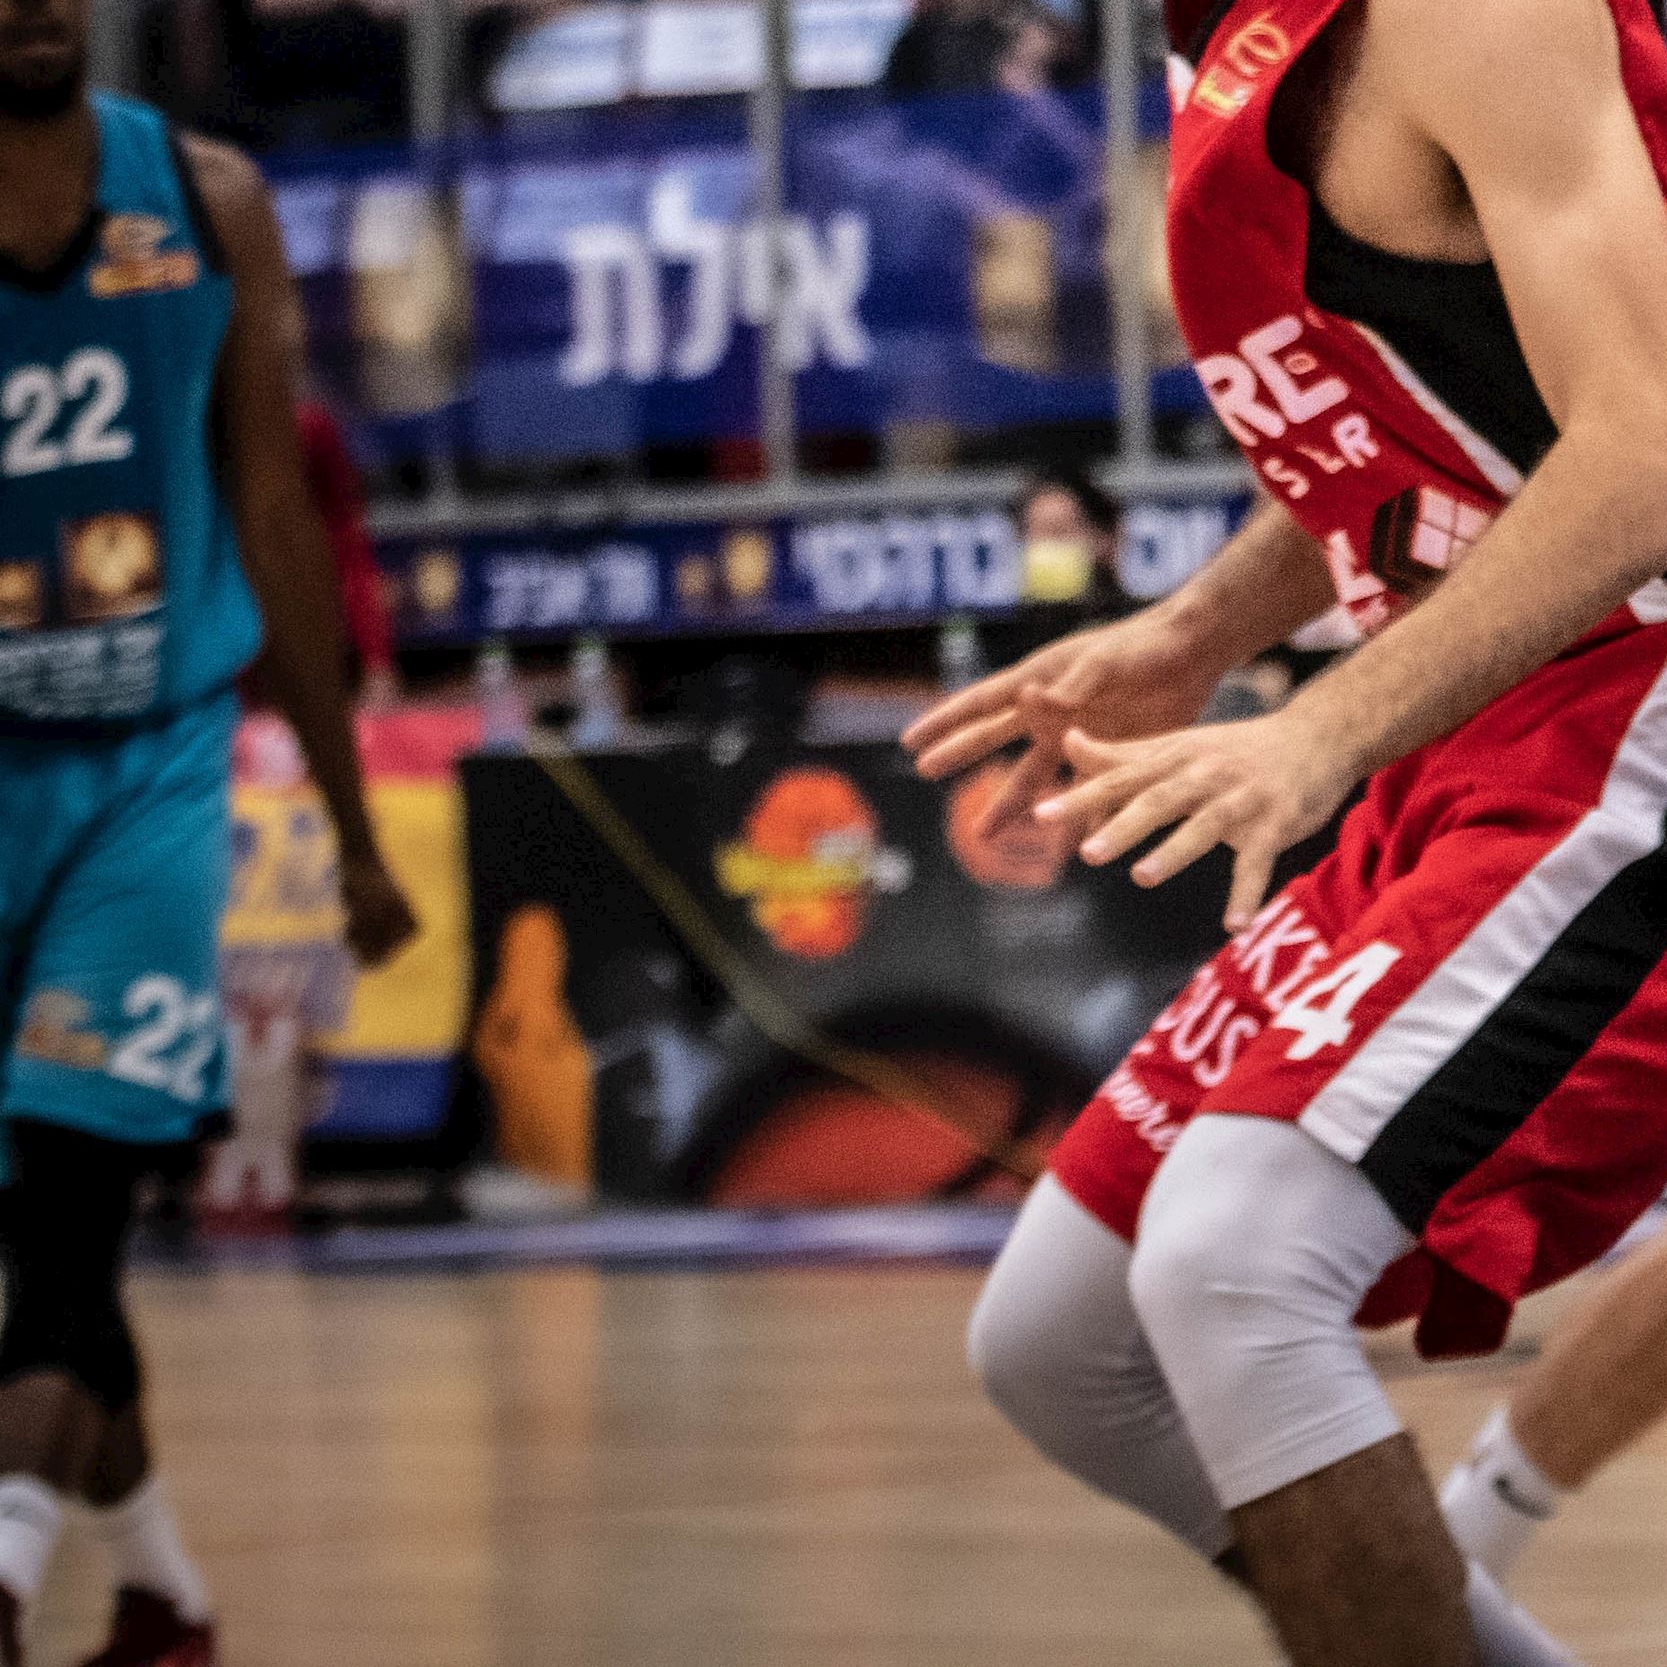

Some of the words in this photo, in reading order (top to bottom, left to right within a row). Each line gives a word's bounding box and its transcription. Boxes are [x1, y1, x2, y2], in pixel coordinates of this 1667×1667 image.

[562, 174, 870, 387] אילת
[0, 344, 136, 479] 22
[1272, 940, 1404, 1061] 4
